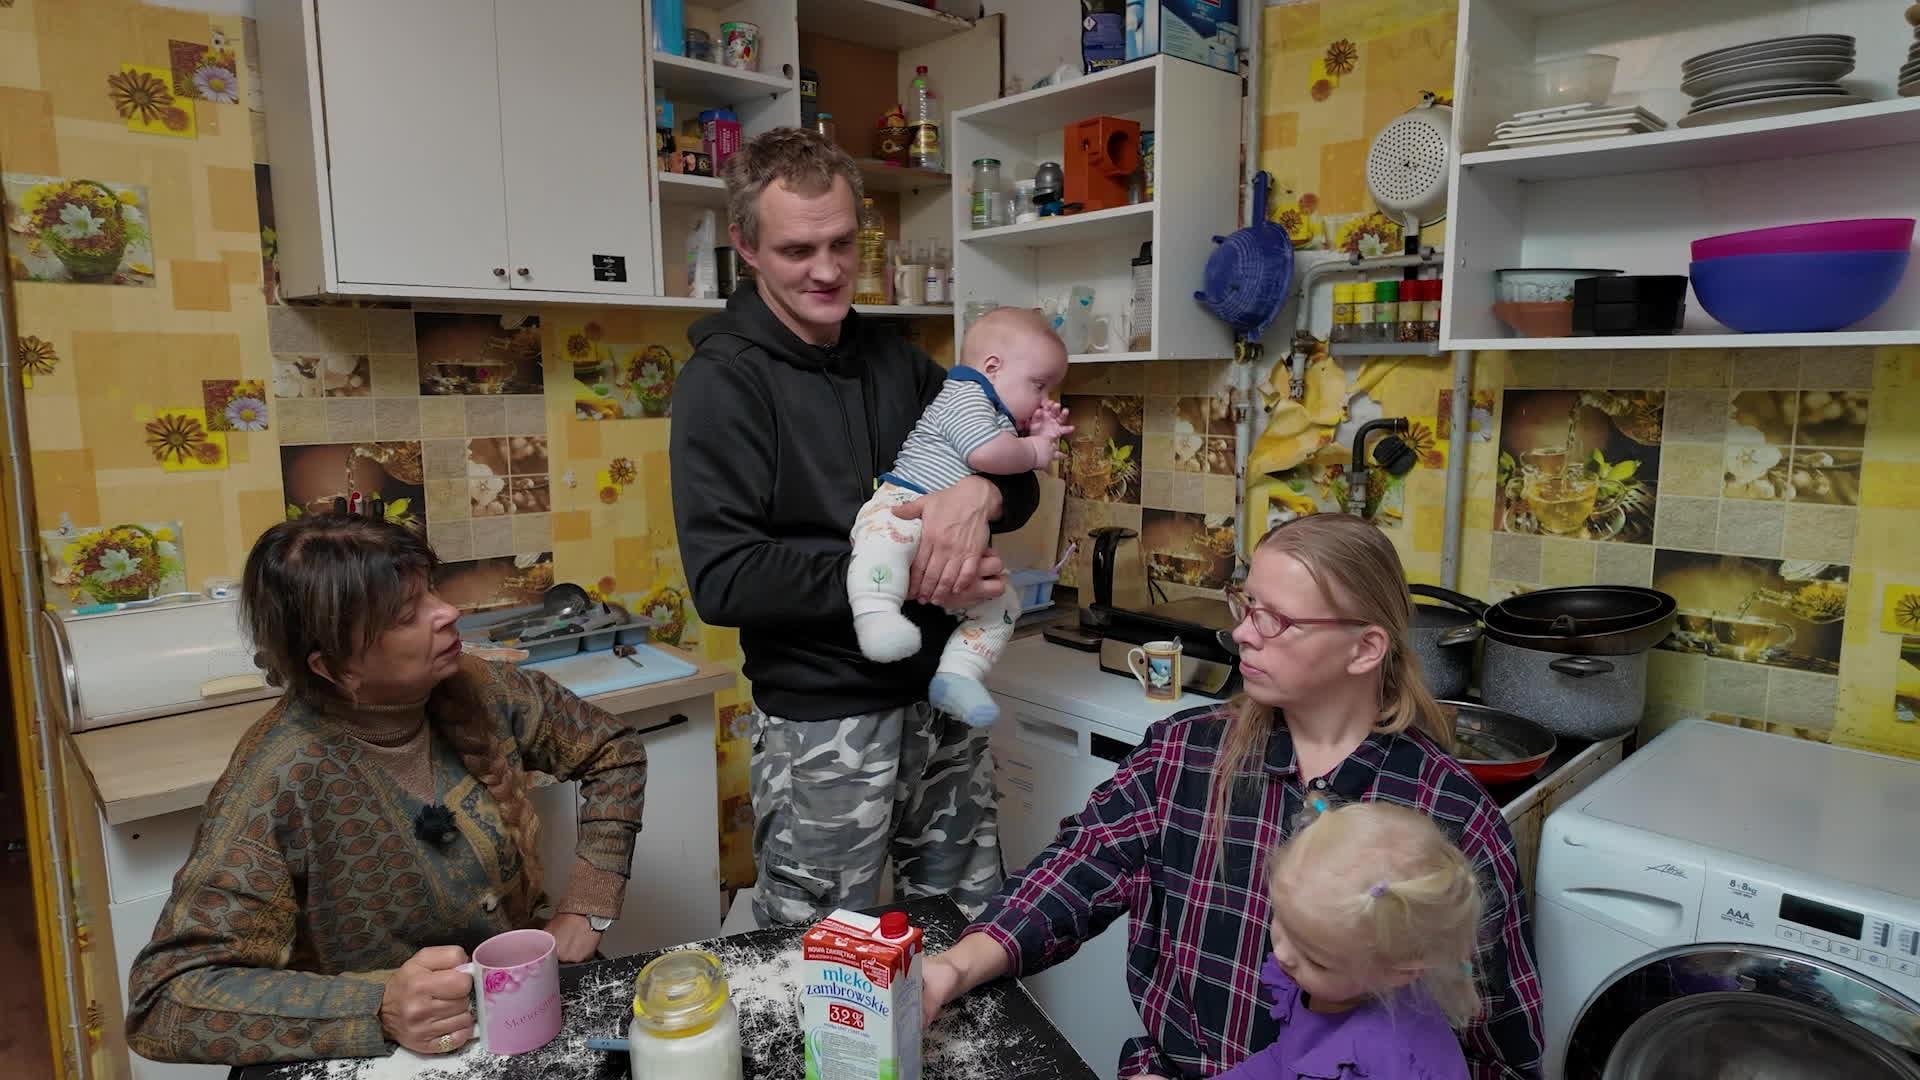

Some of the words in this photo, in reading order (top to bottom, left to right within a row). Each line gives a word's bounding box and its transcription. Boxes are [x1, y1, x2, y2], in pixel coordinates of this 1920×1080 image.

[807, 946, 825, 954] NOWA
[823, 966, 873, 993] mleko
[805, 982, 890, 1017] zambrowskie
